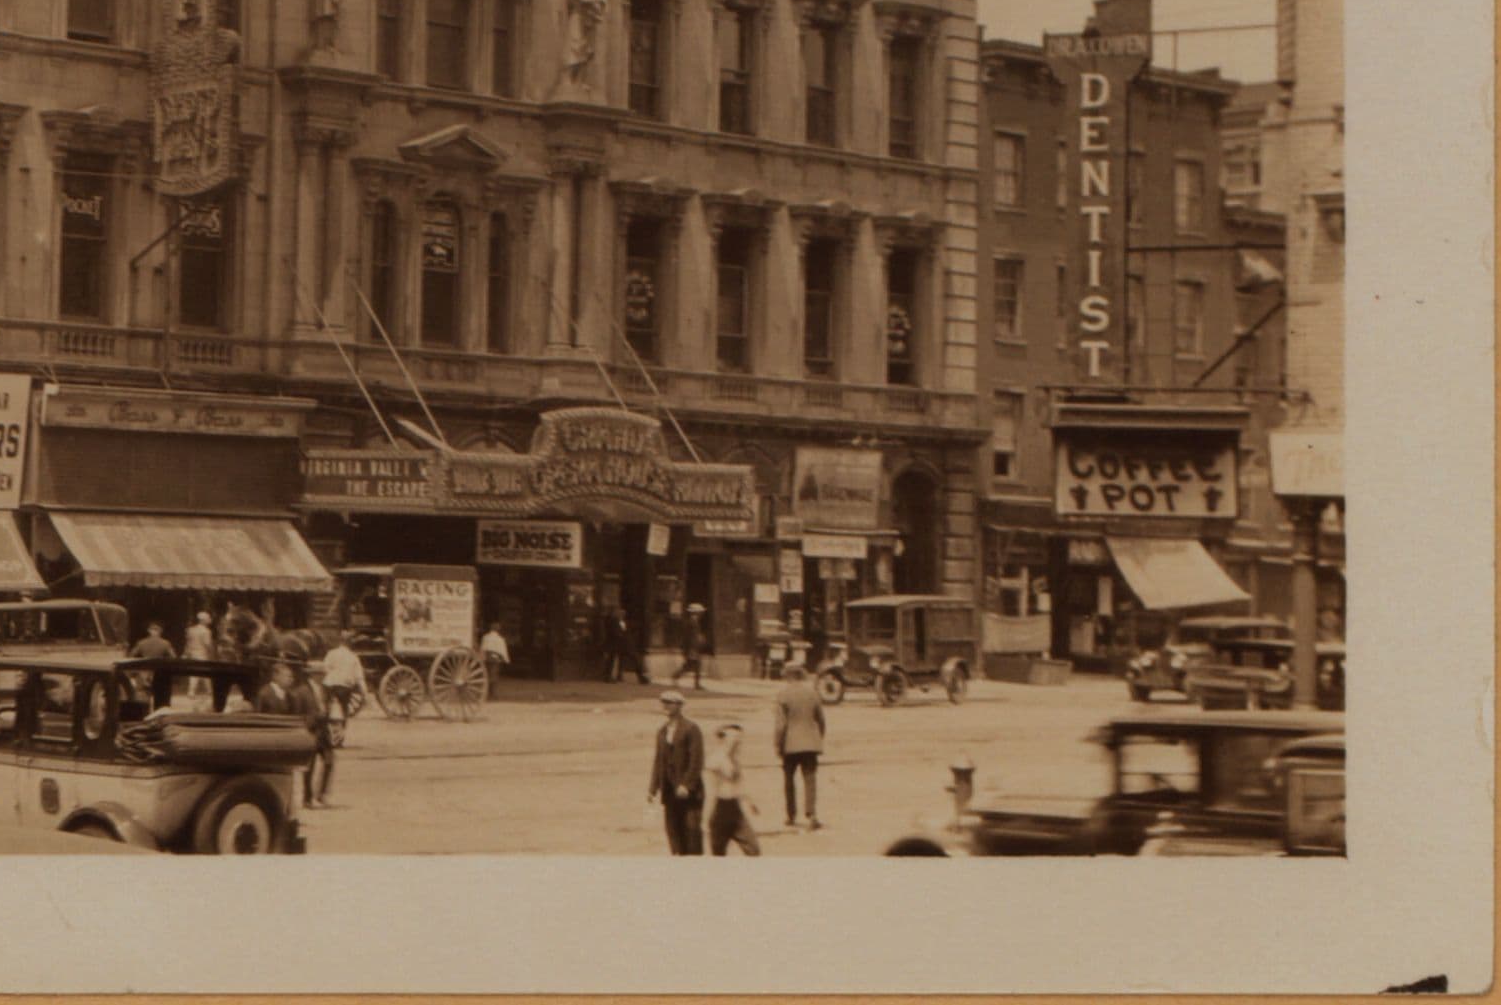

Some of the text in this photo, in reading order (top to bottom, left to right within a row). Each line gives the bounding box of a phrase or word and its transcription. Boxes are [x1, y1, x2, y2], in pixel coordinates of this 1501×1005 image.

[1079, 71, 1112, 378] DENTIST
[1068, 446, 1223, 481] COFFEE
[377, 480, 426, 497] ESCAPE
[1100, 484, 1181, 512] POT
[513, 531, 573, 551] NOISE
[398, 581, 469, 597] RACING
